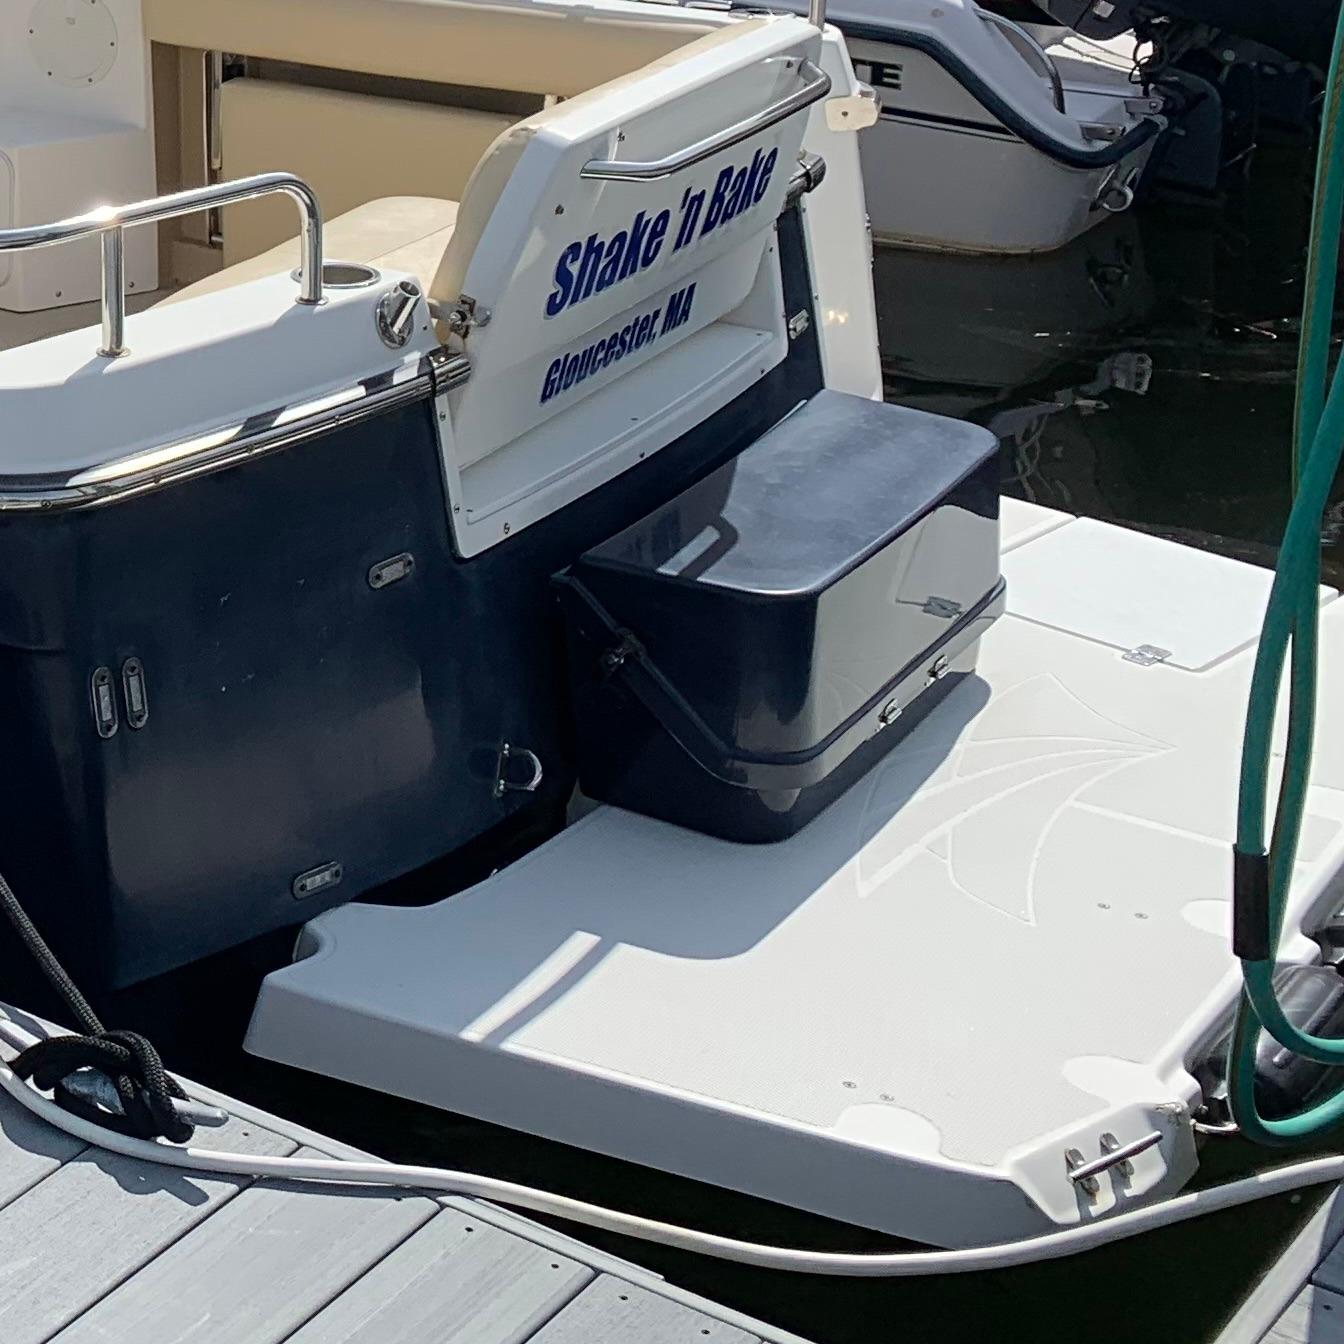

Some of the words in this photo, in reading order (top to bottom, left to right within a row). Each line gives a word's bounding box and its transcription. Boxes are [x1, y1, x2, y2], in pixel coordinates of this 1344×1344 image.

[544, 208, 671, 318] Shake
[700, 146, 779, 236] Bake
[540, 307, 660, 406] Gloucester,
[659, 282, 698, 336] MA
